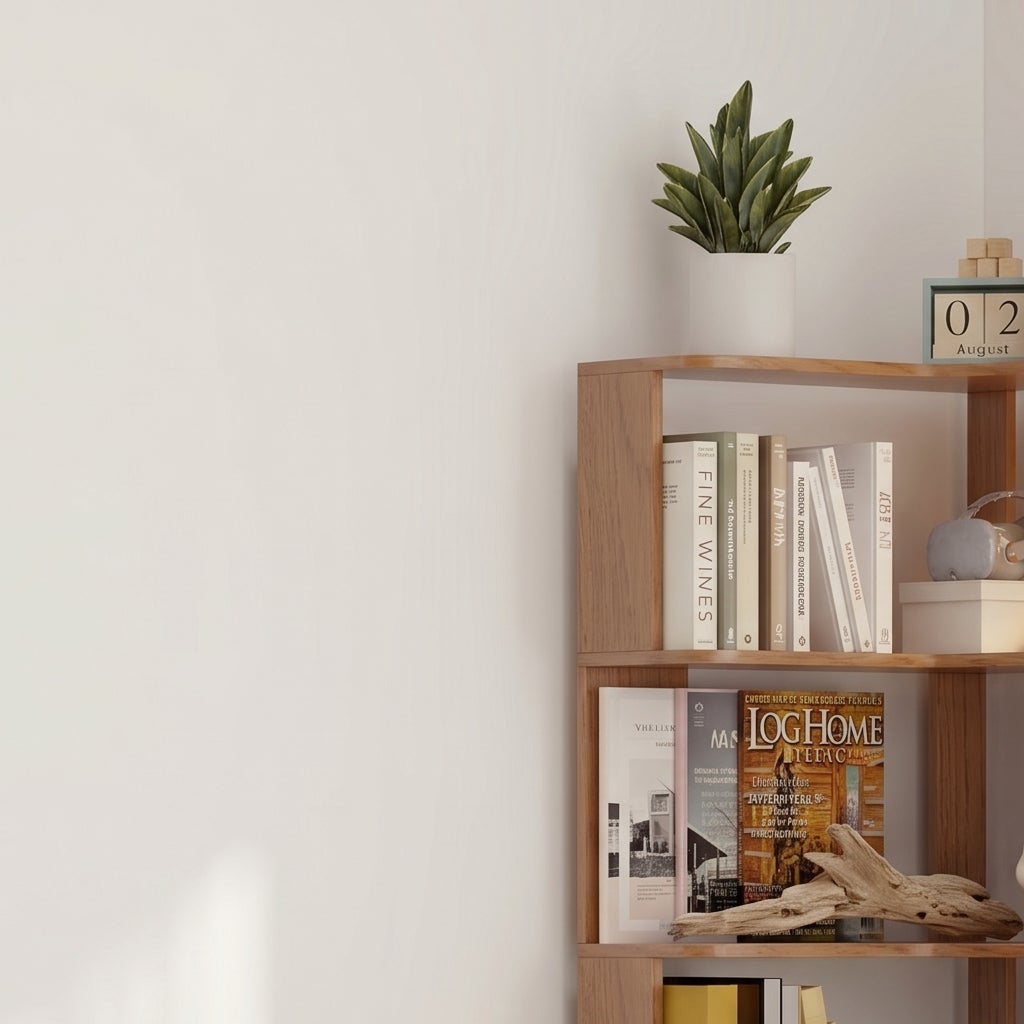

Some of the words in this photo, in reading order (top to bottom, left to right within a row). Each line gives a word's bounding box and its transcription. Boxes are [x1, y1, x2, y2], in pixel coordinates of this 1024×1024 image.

[957, 343, 1010, 358] August
[698, 471, 712, 525] FINE
[698, 540, 712, 622] WINES
